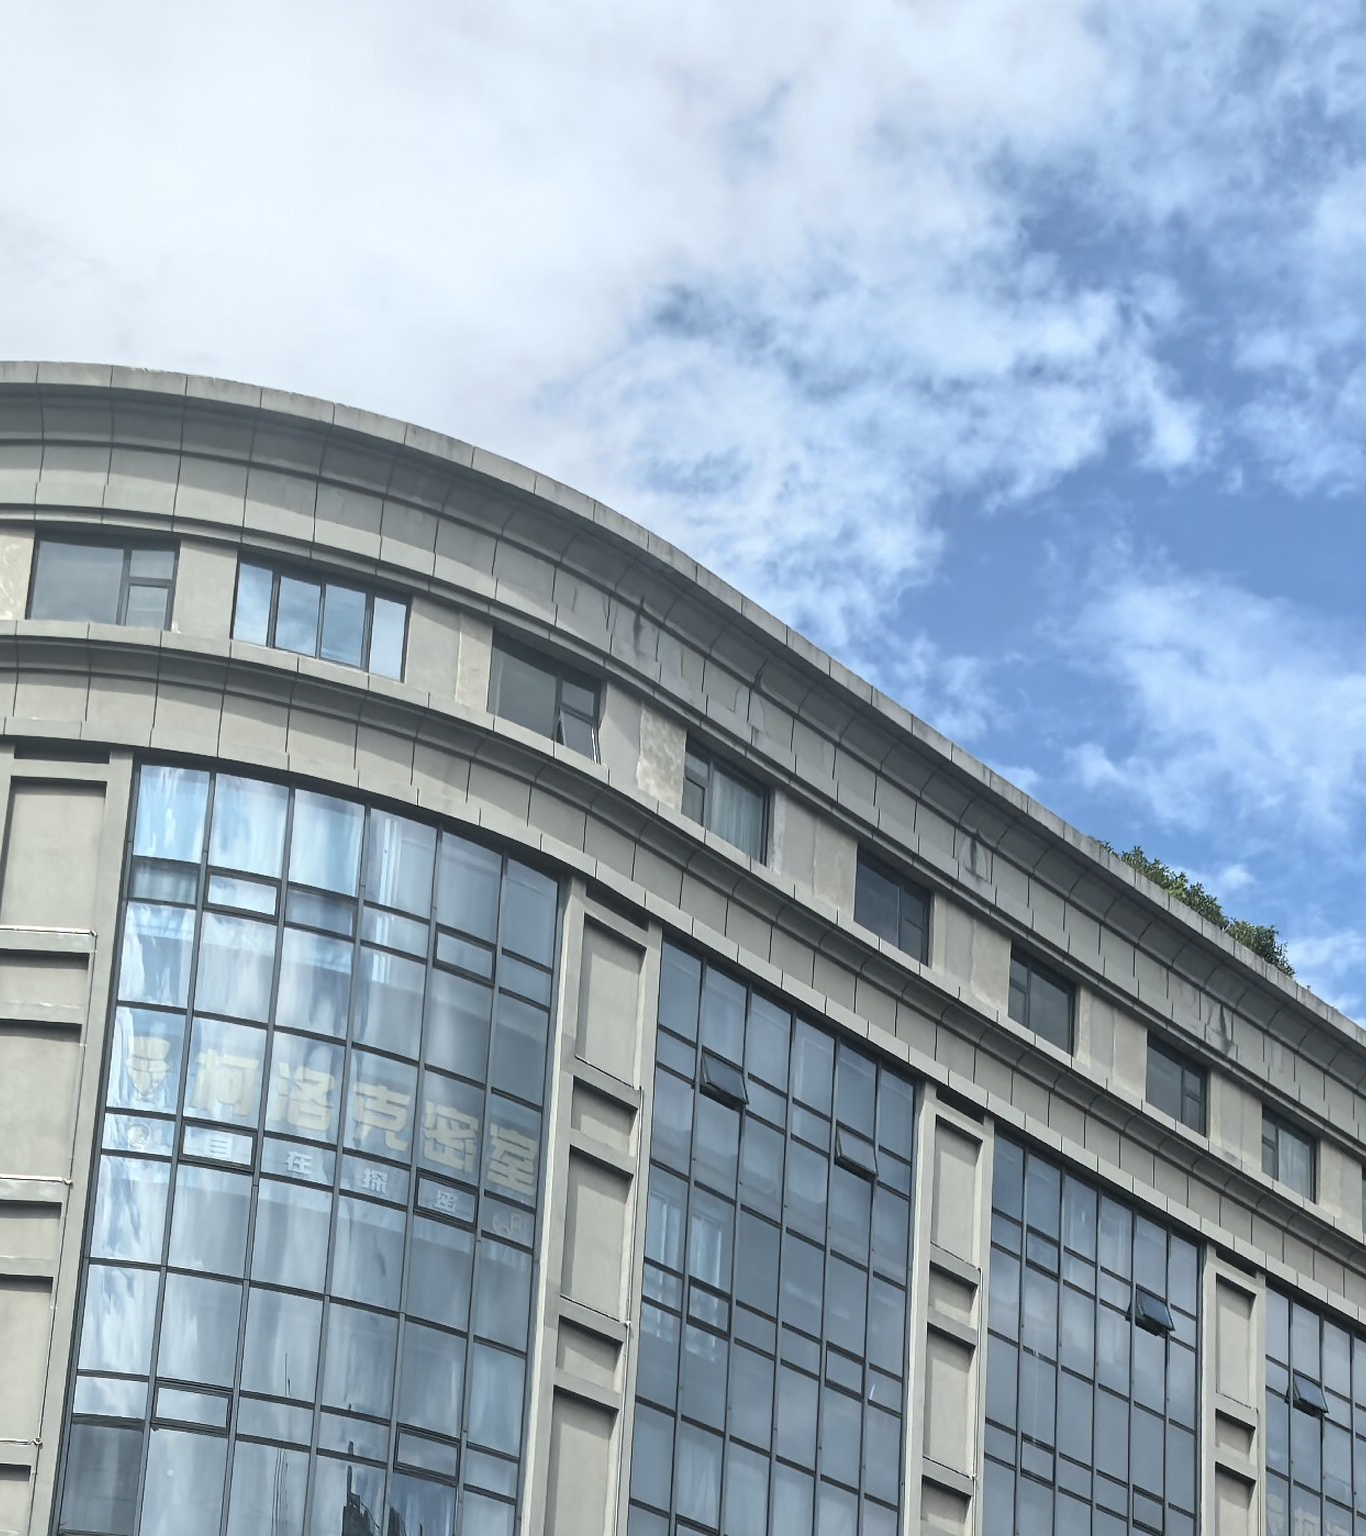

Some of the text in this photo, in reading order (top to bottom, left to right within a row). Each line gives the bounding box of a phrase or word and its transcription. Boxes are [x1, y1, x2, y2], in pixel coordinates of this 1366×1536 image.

[190, 1048, 536, 1196] 柯洛克密室
